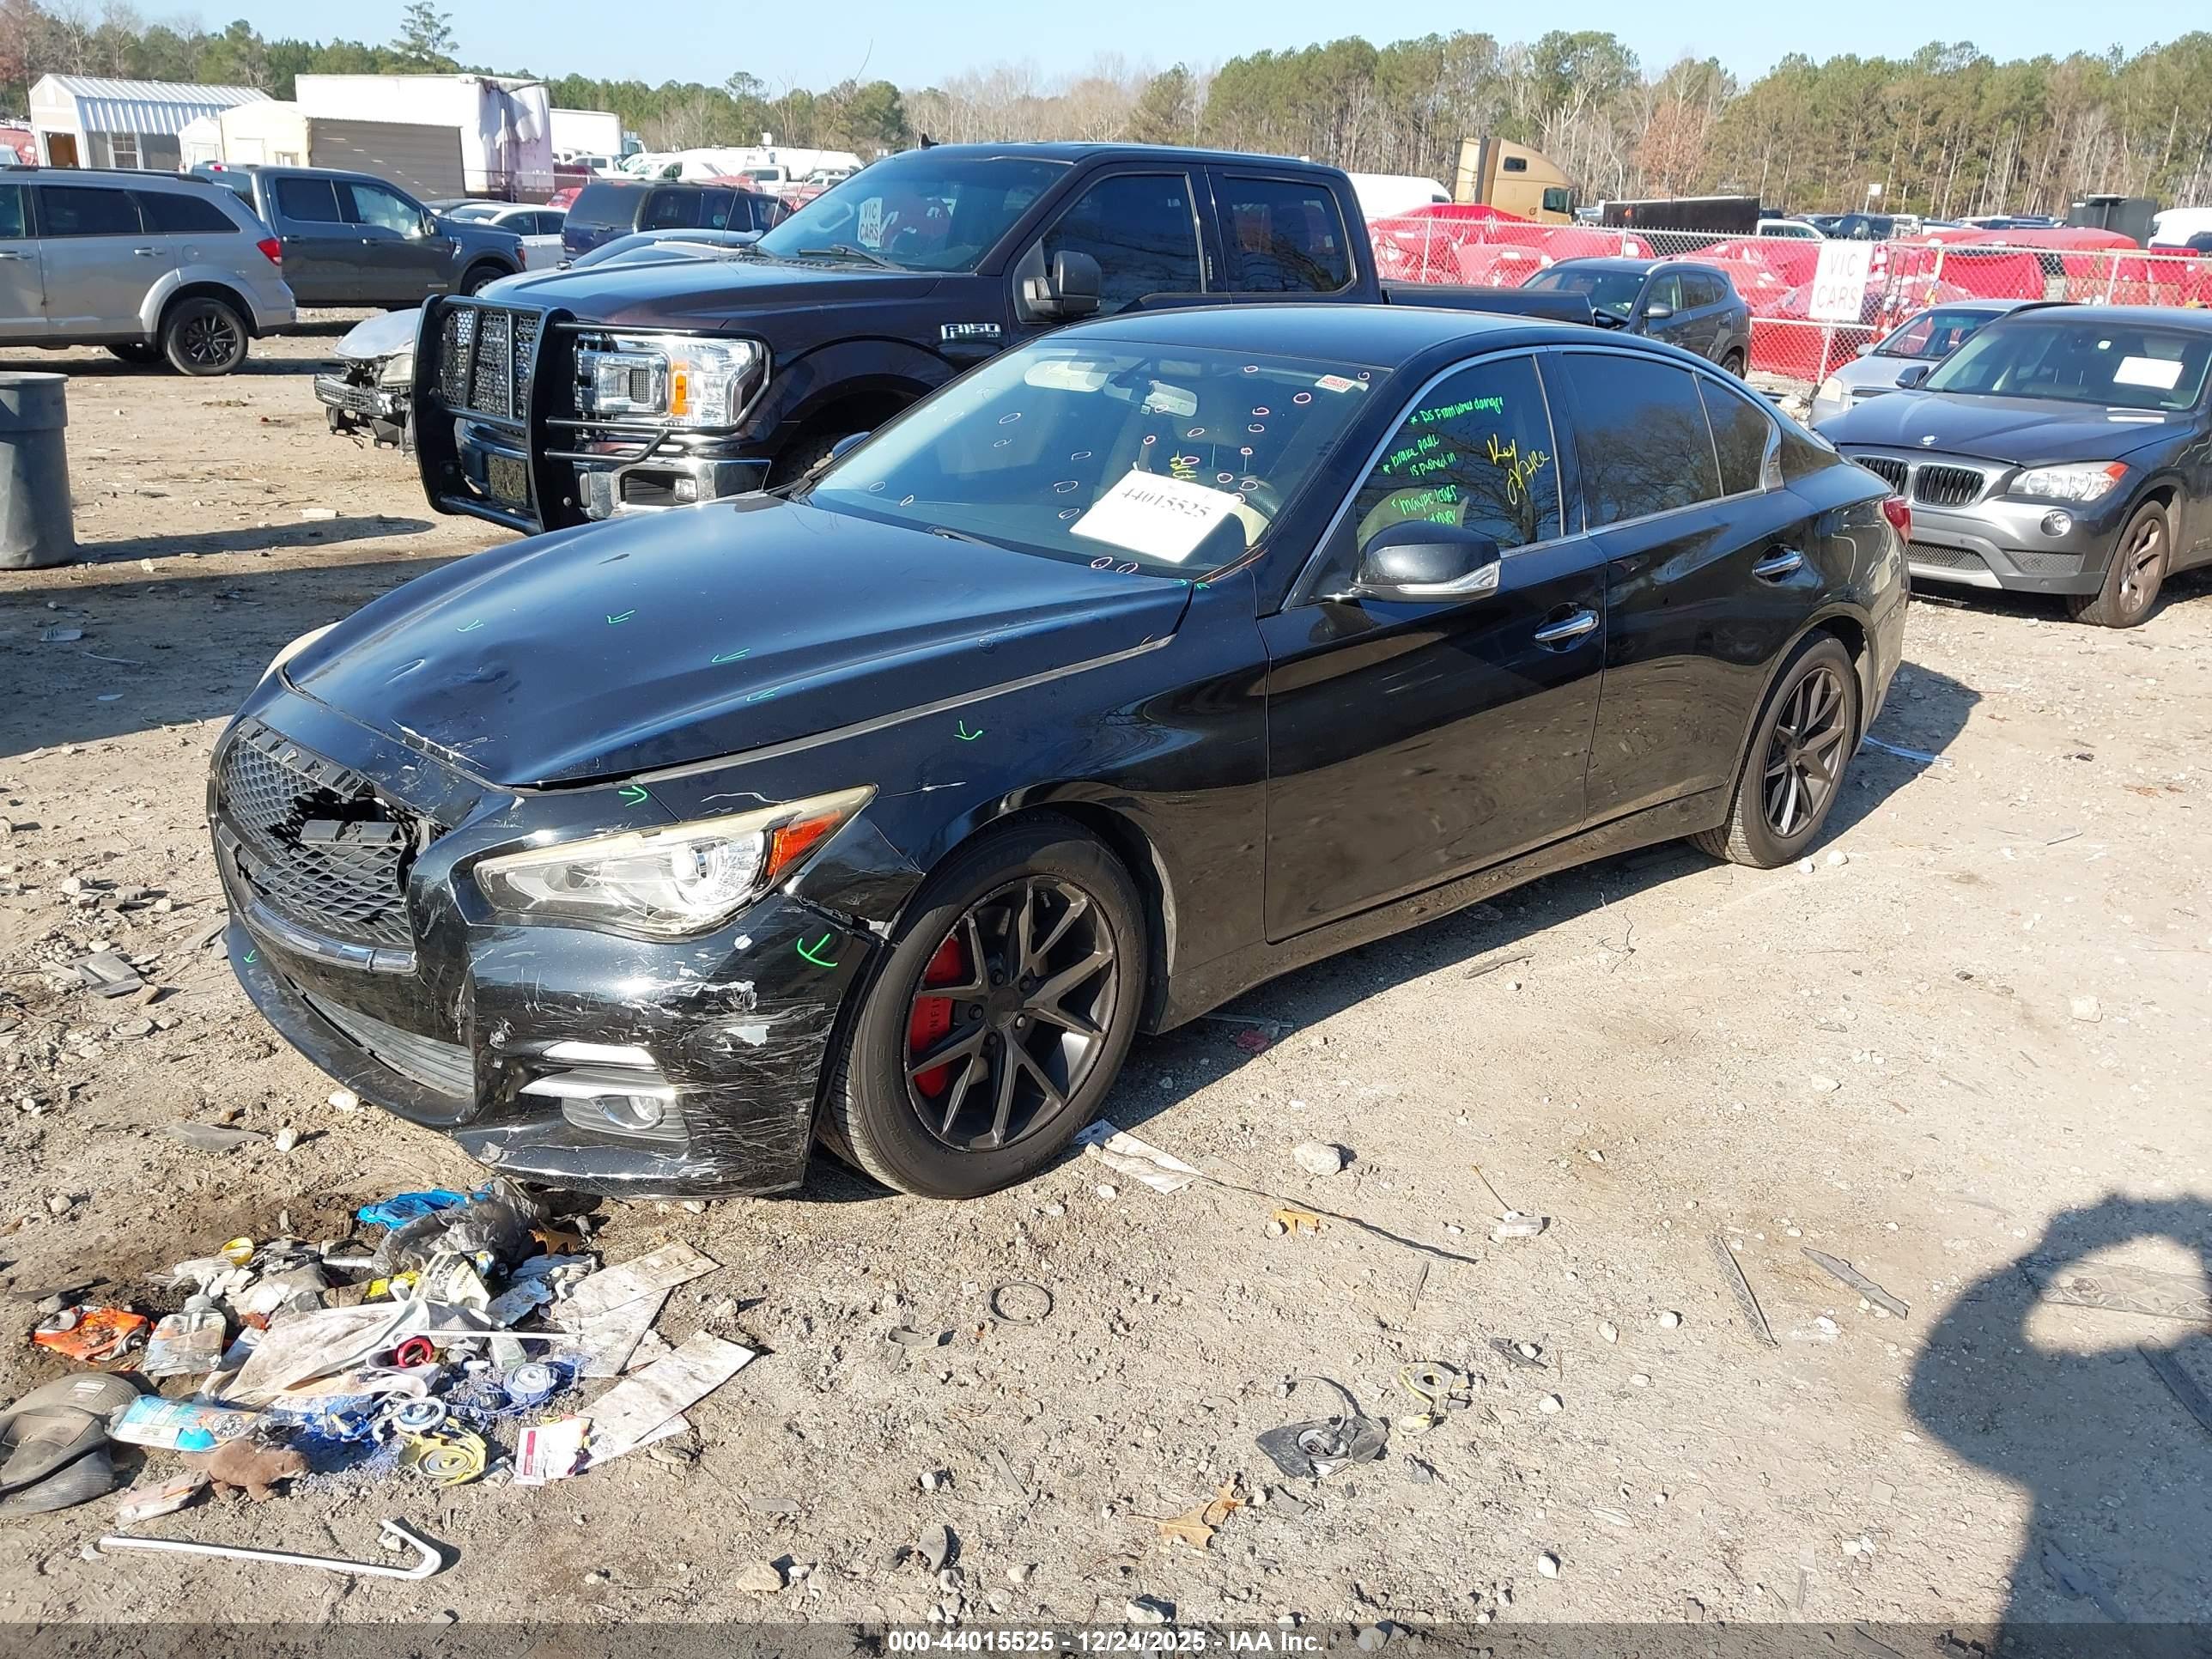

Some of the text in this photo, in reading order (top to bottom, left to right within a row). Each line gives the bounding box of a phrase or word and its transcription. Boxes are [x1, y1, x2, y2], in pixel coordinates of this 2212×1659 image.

[864, 203, 878, 219] VIC
[859, 223, 879, 241] CARS
[1830, 252, 1859, 277] VIC
[1816, 284, 1859, 311] CARS
[1121, 487, 1213, 518] 44015525
